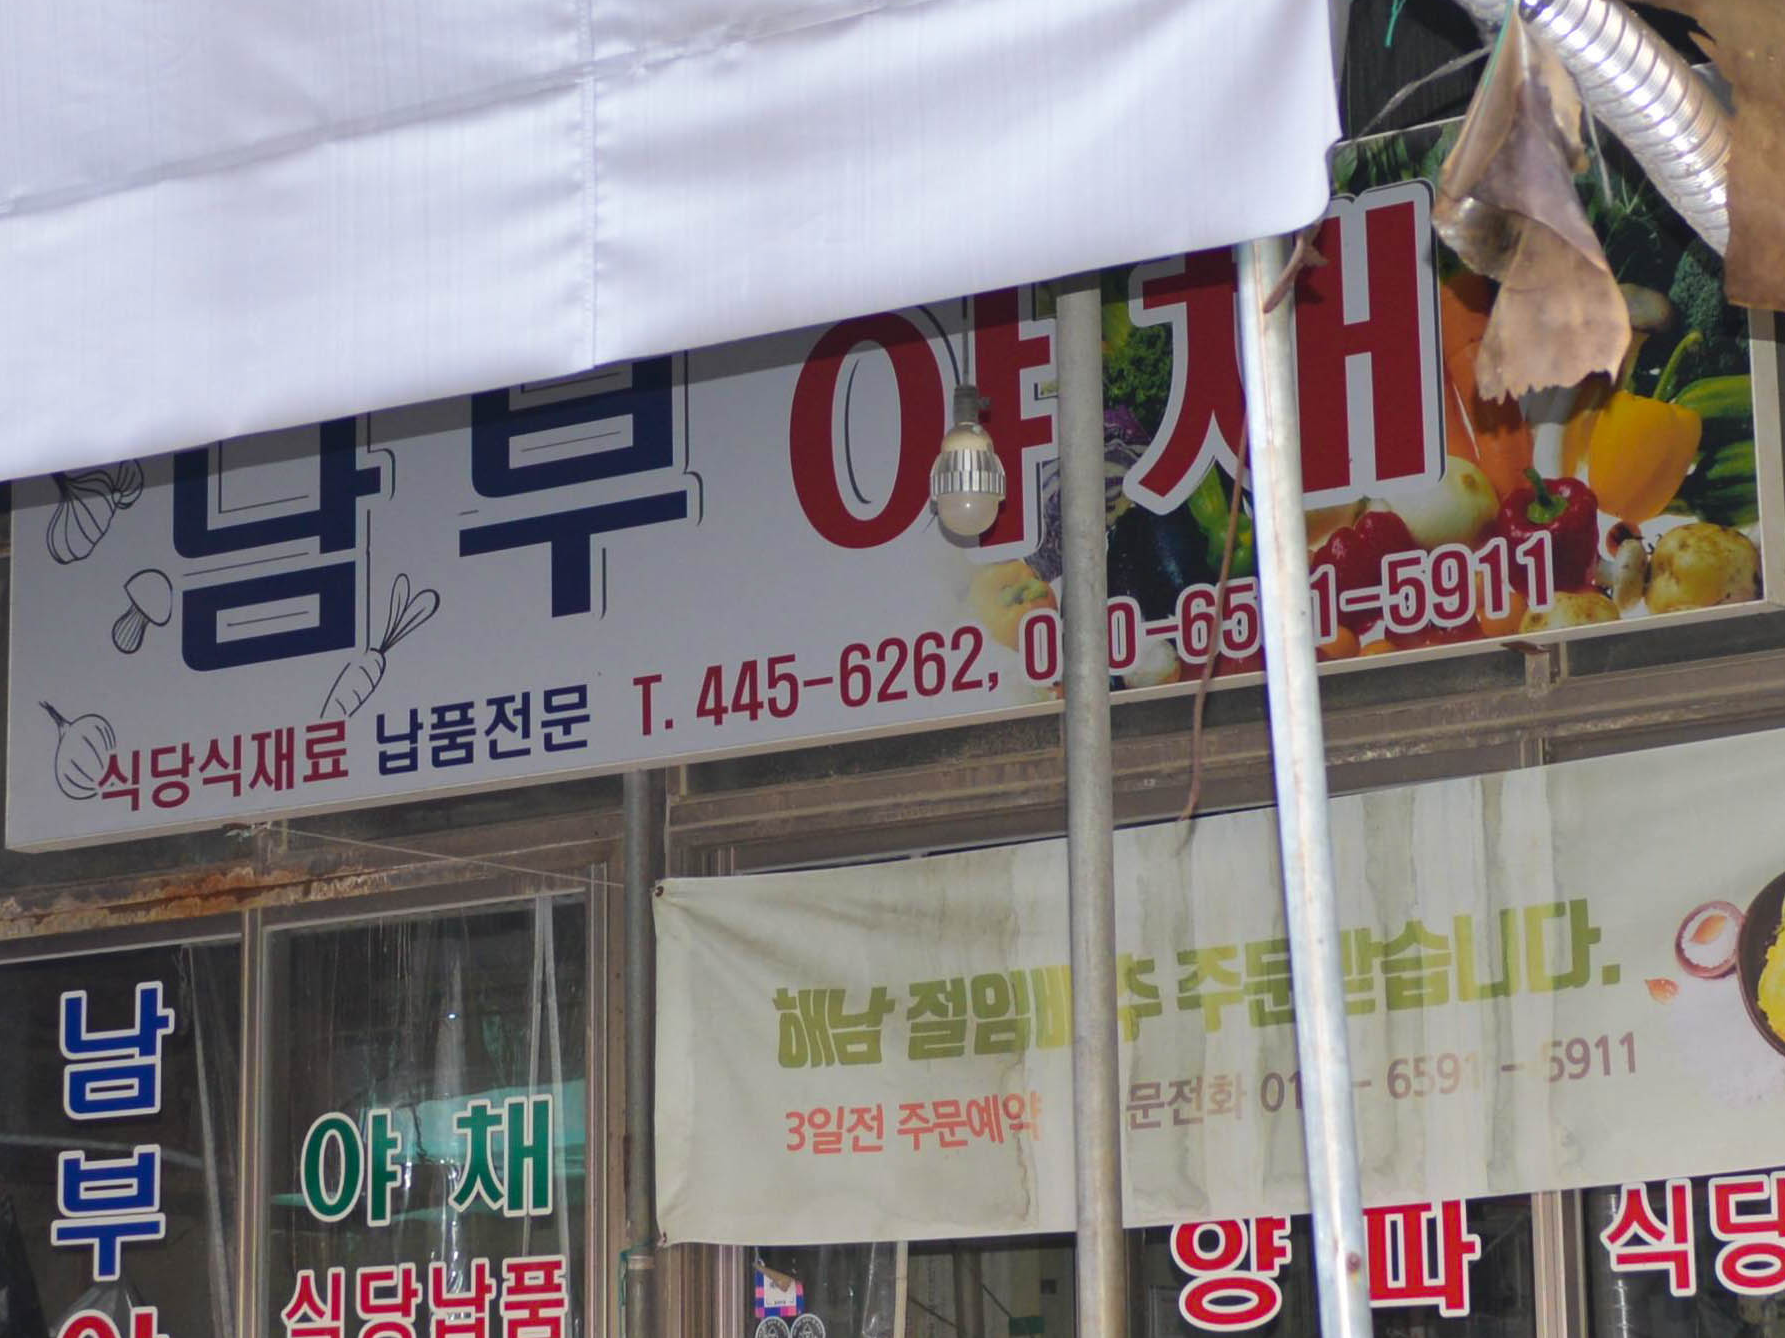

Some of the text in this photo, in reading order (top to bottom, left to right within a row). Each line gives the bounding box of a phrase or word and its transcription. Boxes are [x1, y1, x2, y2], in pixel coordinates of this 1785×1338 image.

[97, 719, 350, 812] 식당식재료
[375, 683, 591, 776] 납품전문
[1024, 531, 1552, 682] 00-651-5911
[772, 985, 895, 1069] 해남
[785, 1108, 884, 1155] 3일전
[896, 1091, 1043, 1154] 주문예약
[1125, 1071, 1247, 1130] 문전화
